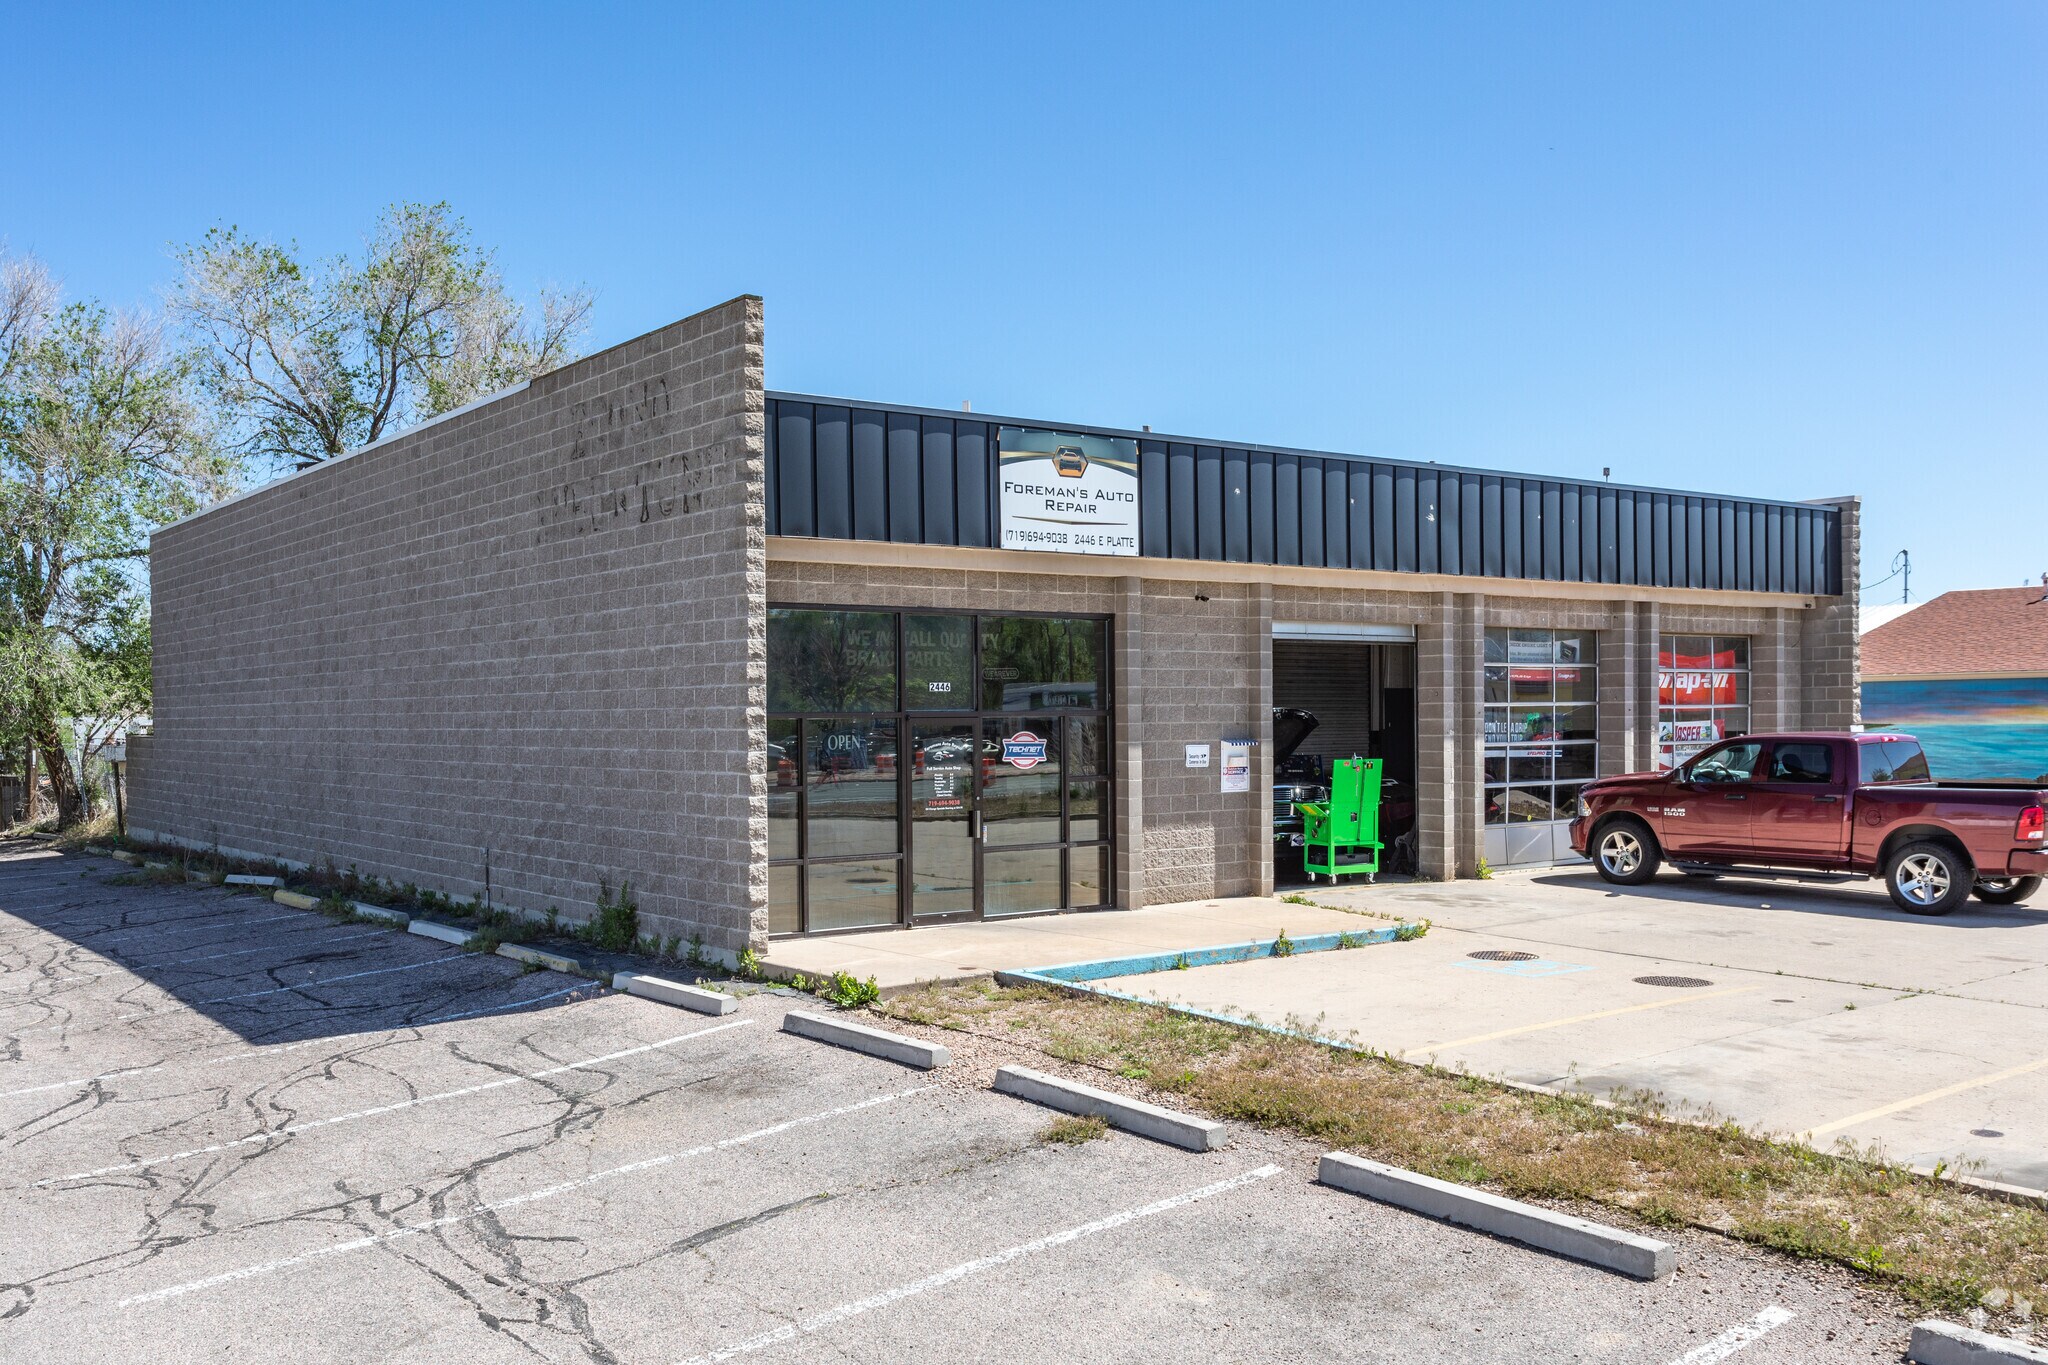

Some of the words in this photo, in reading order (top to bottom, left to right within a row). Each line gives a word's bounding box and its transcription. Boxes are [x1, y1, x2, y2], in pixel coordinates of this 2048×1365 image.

[1004, 481, 1088, 499] FOREMAN'S
[1095, 489, 1134, 503] AUTO
[1045, 499, 1097, 514] REPAIR
[1005, 529, 1068, 544] (719)694-9038
[1074, 534, 1096, 546] 2446
[1098, 535, 1104, 546] E
[1106, 536, 1135, 548] PLATTE
[846, 630, 872, 646] WE
[940, 631, 999, 650] QUATY
[905, 650, 952, 667] PARTS
[930, 683, 950, 691] 2446
[1484, 720, 1500, 733] DON'T
[828, 734, 860, 750] OPEN
